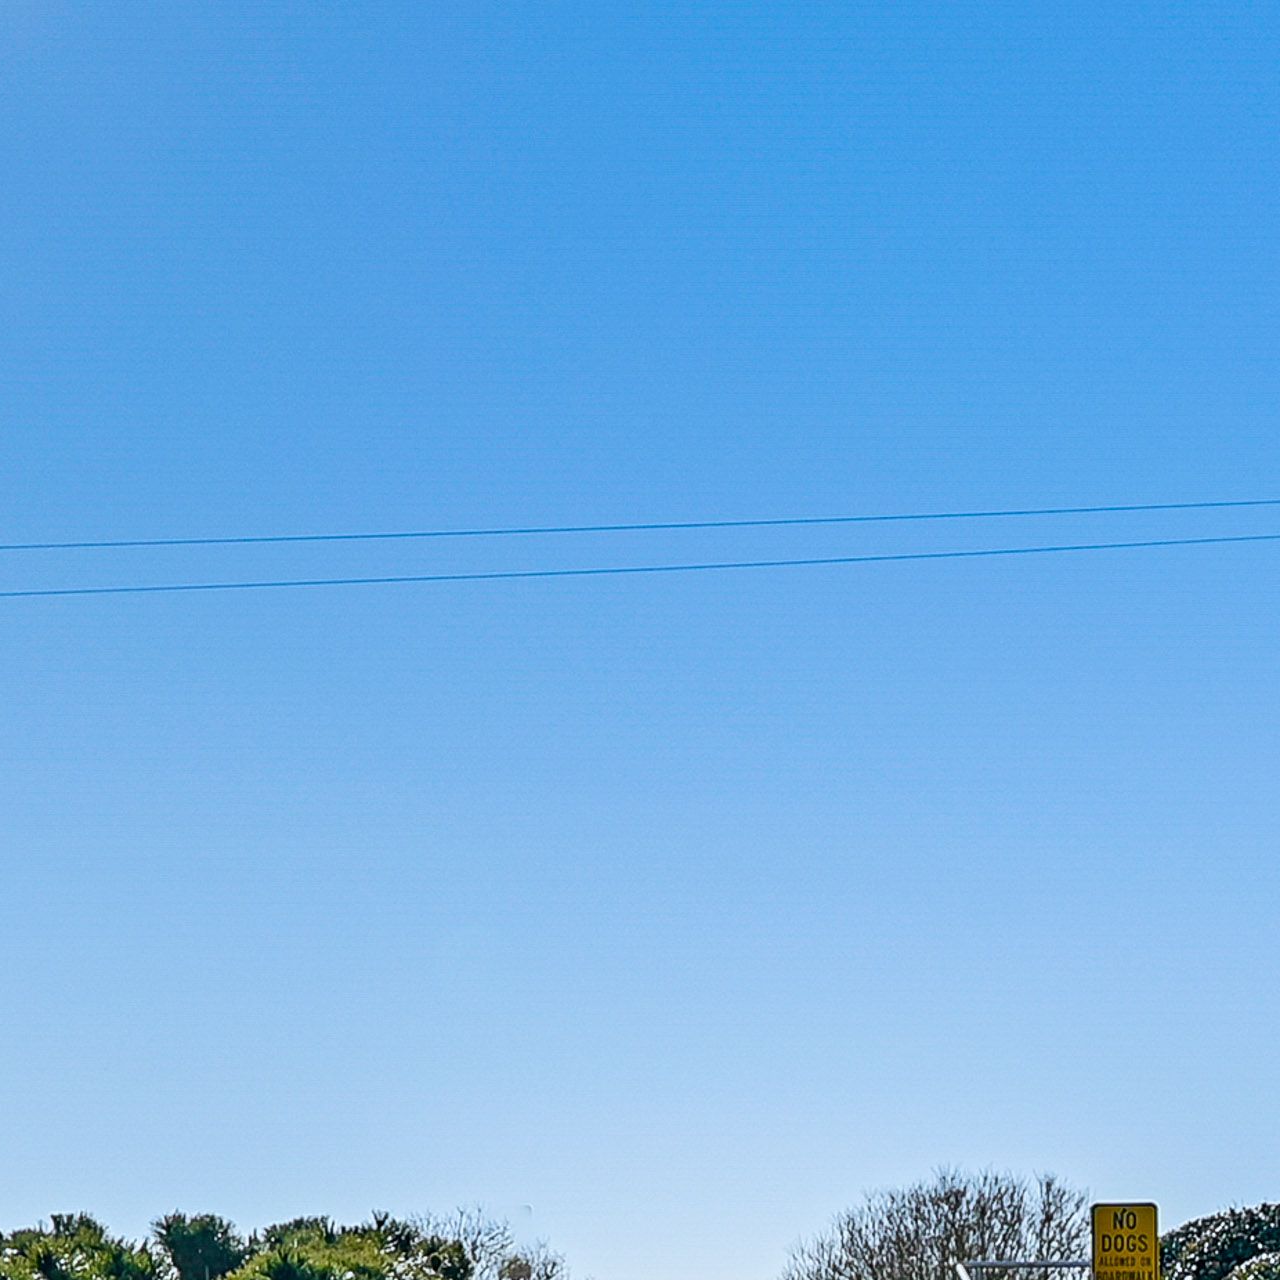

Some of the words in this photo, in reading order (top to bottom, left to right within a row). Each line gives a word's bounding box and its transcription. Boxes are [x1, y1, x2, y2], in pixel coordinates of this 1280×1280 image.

[1113, 1211, 1136, 1230] NO
[1102, 1234, 1148, 1252] DOGS
[1098, 1256, 1136, 1267] ALLOWED
[1140, 1256, 1151, 1267] ON
